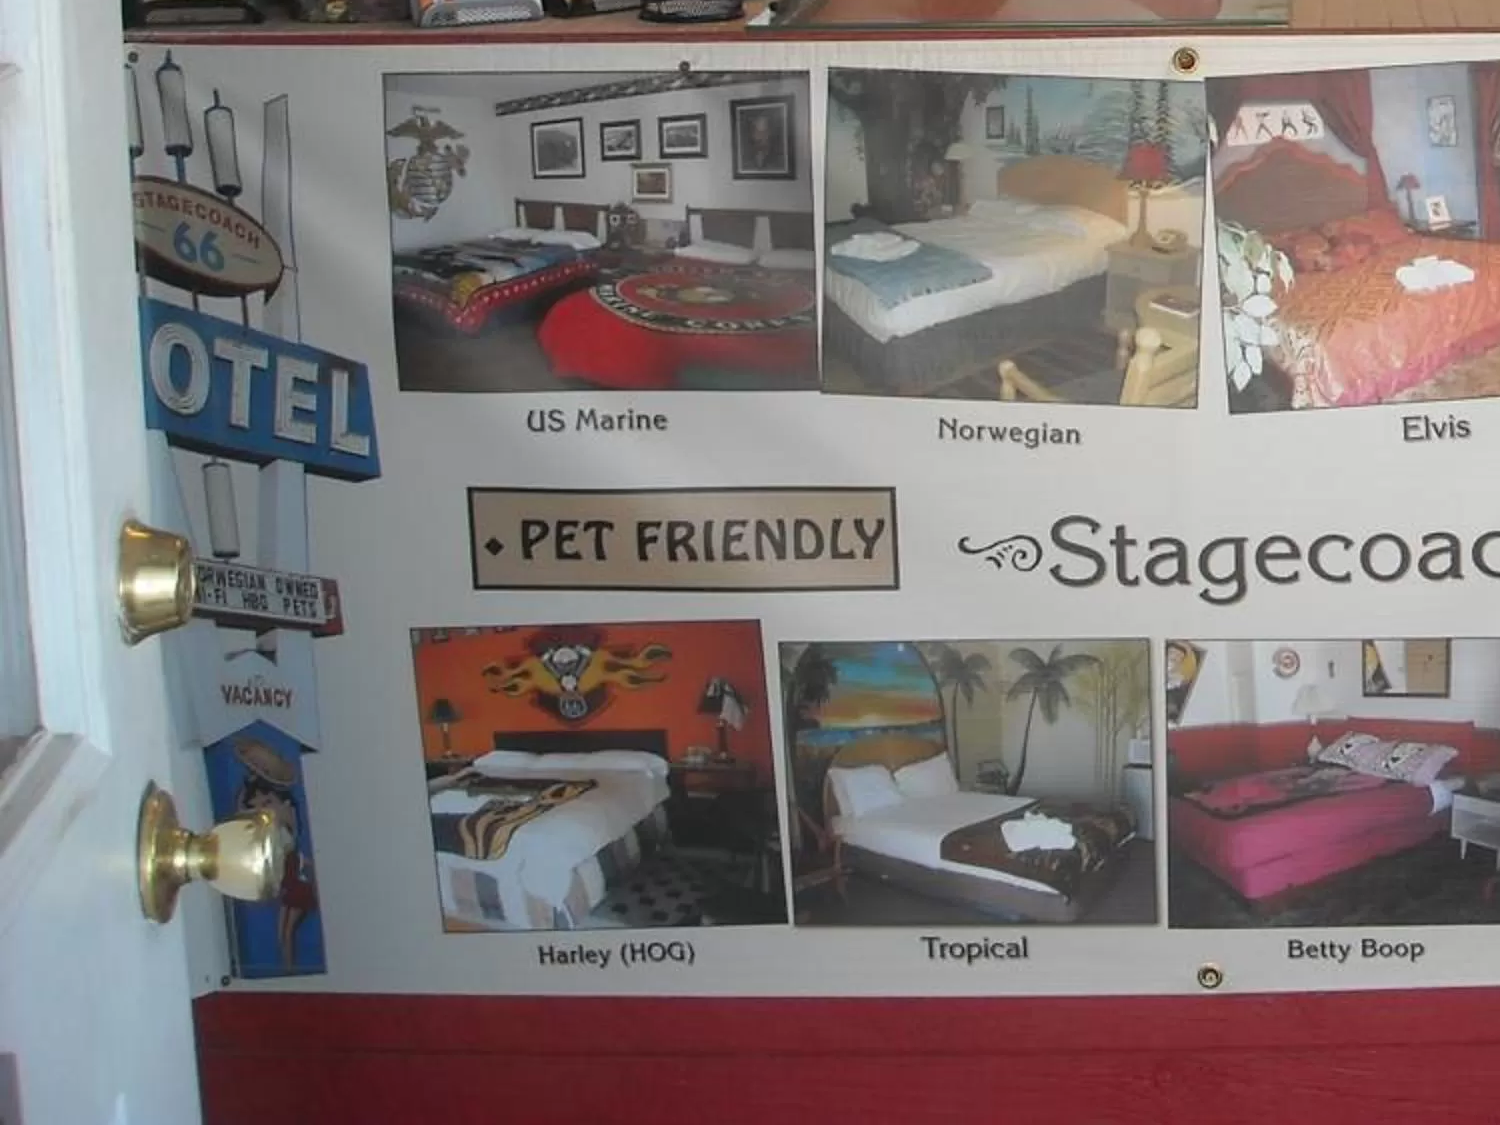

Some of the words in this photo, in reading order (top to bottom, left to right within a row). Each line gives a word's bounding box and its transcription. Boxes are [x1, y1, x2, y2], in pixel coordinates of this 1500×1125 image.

[134, 191, 262, 250] STAGECOACH
[172, 220, 226, 272] 66
[147, 321, 373, 459] OTEL
[526, 409, 566, 433] US
[576, 408, 669, 433] Marine
[938, 417, 1082, 448] Norwegian
[1402, 415, 1472, 443] Elvis
[520, 518, 615, 562] PET
[636, 517, 887, 563] FRIENDLY
[196, 564, 266, 591] ORWEGIAN
[275, 576, 319, 600] OWNED
[199, 586, 228, 605] I-FI
[220, 683, 292, 709] VACANCY
[537, 945, 612, 968] Harley
[619, 941, 697, 967] (HOG)
[920, 934, 1030, 962] Tropical
[1287, 939, 1354, 962] Betty
[1361, 937, 1426, 962] Boop
